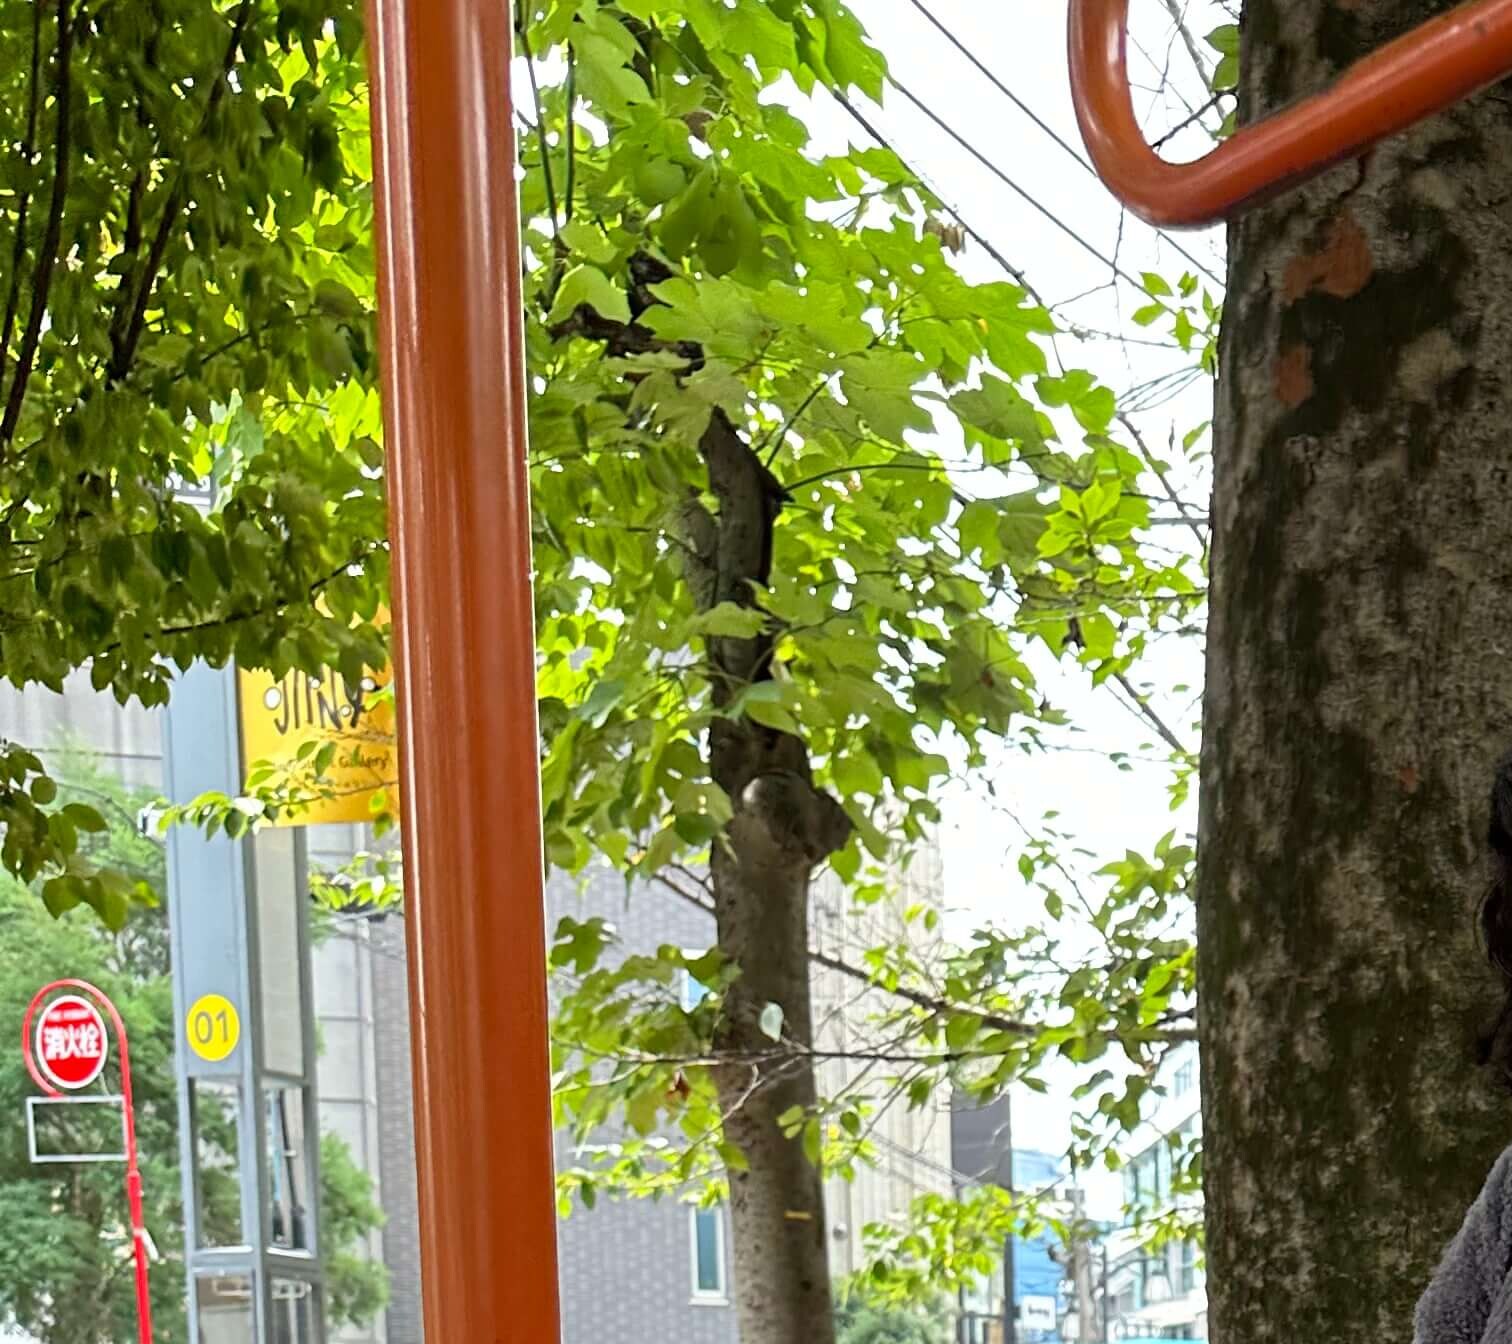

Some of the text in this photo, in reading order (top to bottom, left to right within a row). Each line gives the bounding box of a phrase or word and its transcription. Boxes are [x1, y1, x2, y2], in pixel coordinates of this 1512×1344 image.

[43, 1023, 101, 1061] 消火栓
[195, 1009, 229, 1045] 01
